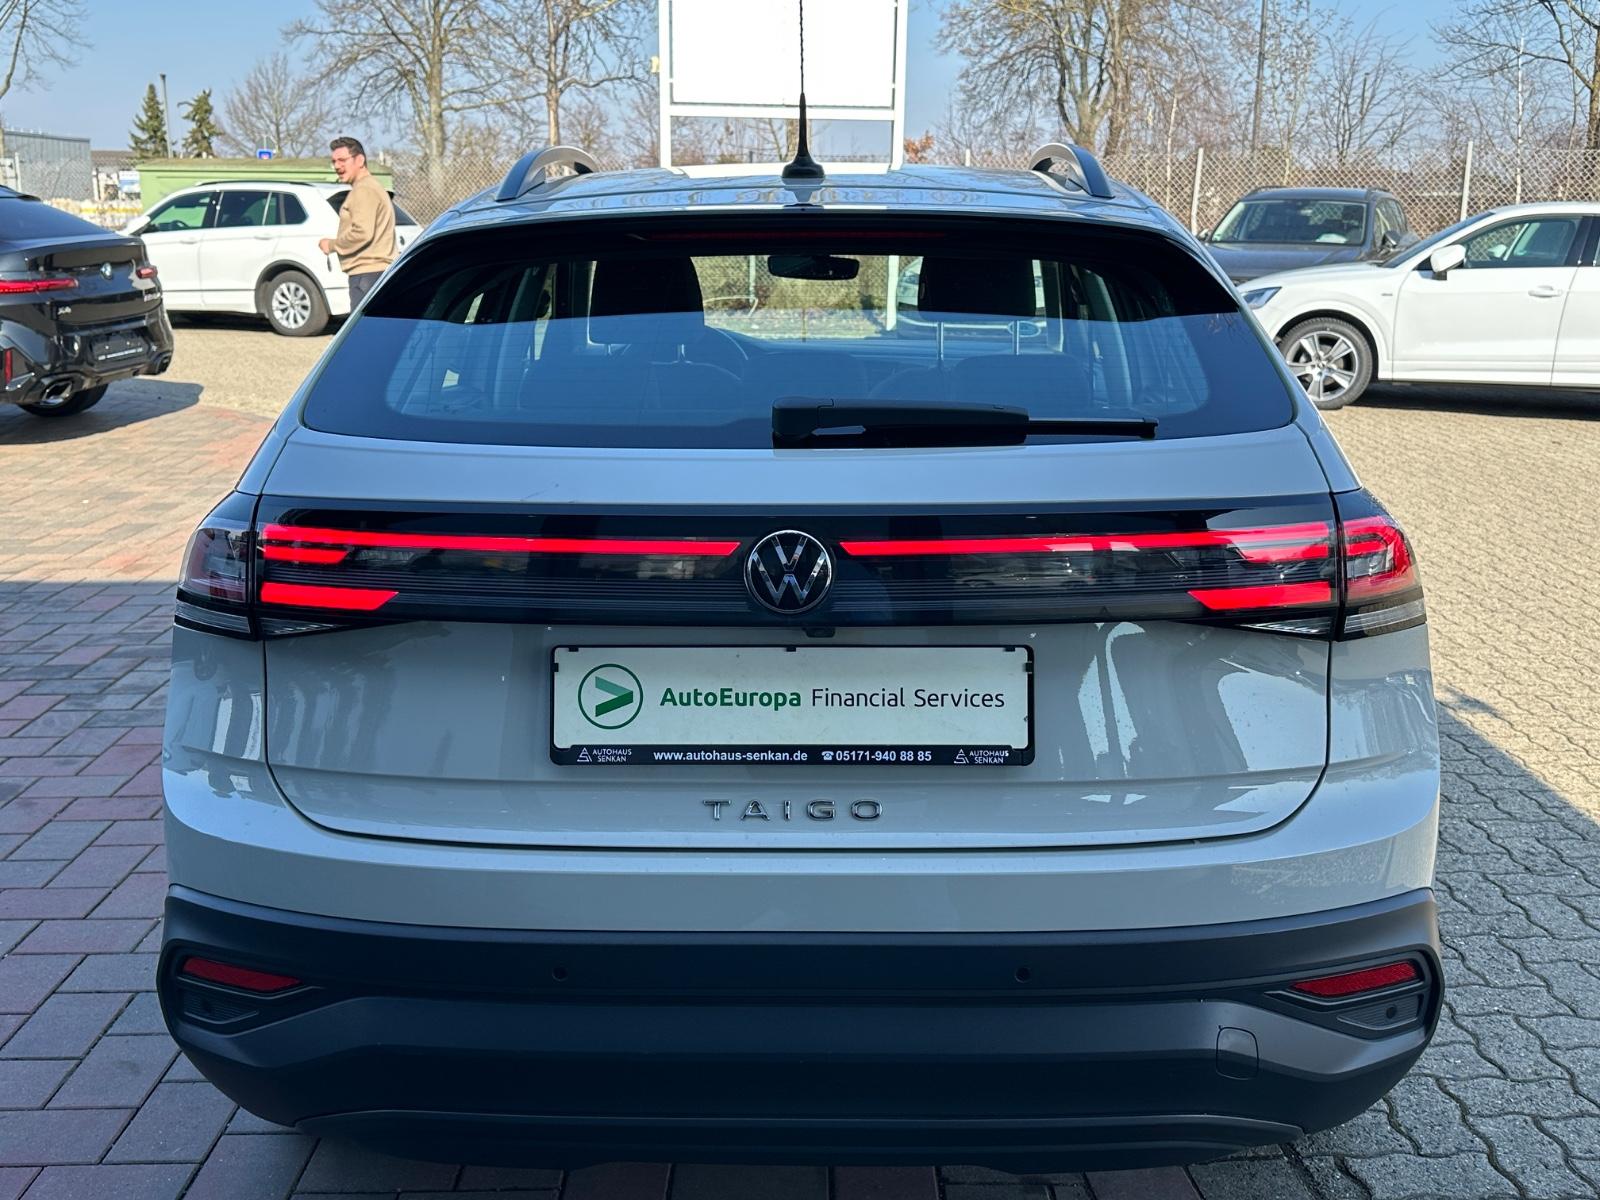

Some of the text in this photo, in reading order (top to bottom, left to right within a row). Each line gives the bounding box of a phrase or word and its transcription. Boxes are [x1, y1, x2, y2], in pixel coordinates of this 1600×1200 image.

[659, 687, 1005, 711] AutoEuropa Financial Services
[592, 748, 632, 756] AUTOHAUS
[653, 749, 932, 762] www.autohaus-senkan.de 05171-940 88 85
[597, 755, 627, 763] SENKAN
[974, 756, 1004, 764] SENKAN
[702, 799, 884, 821] TAIGO
